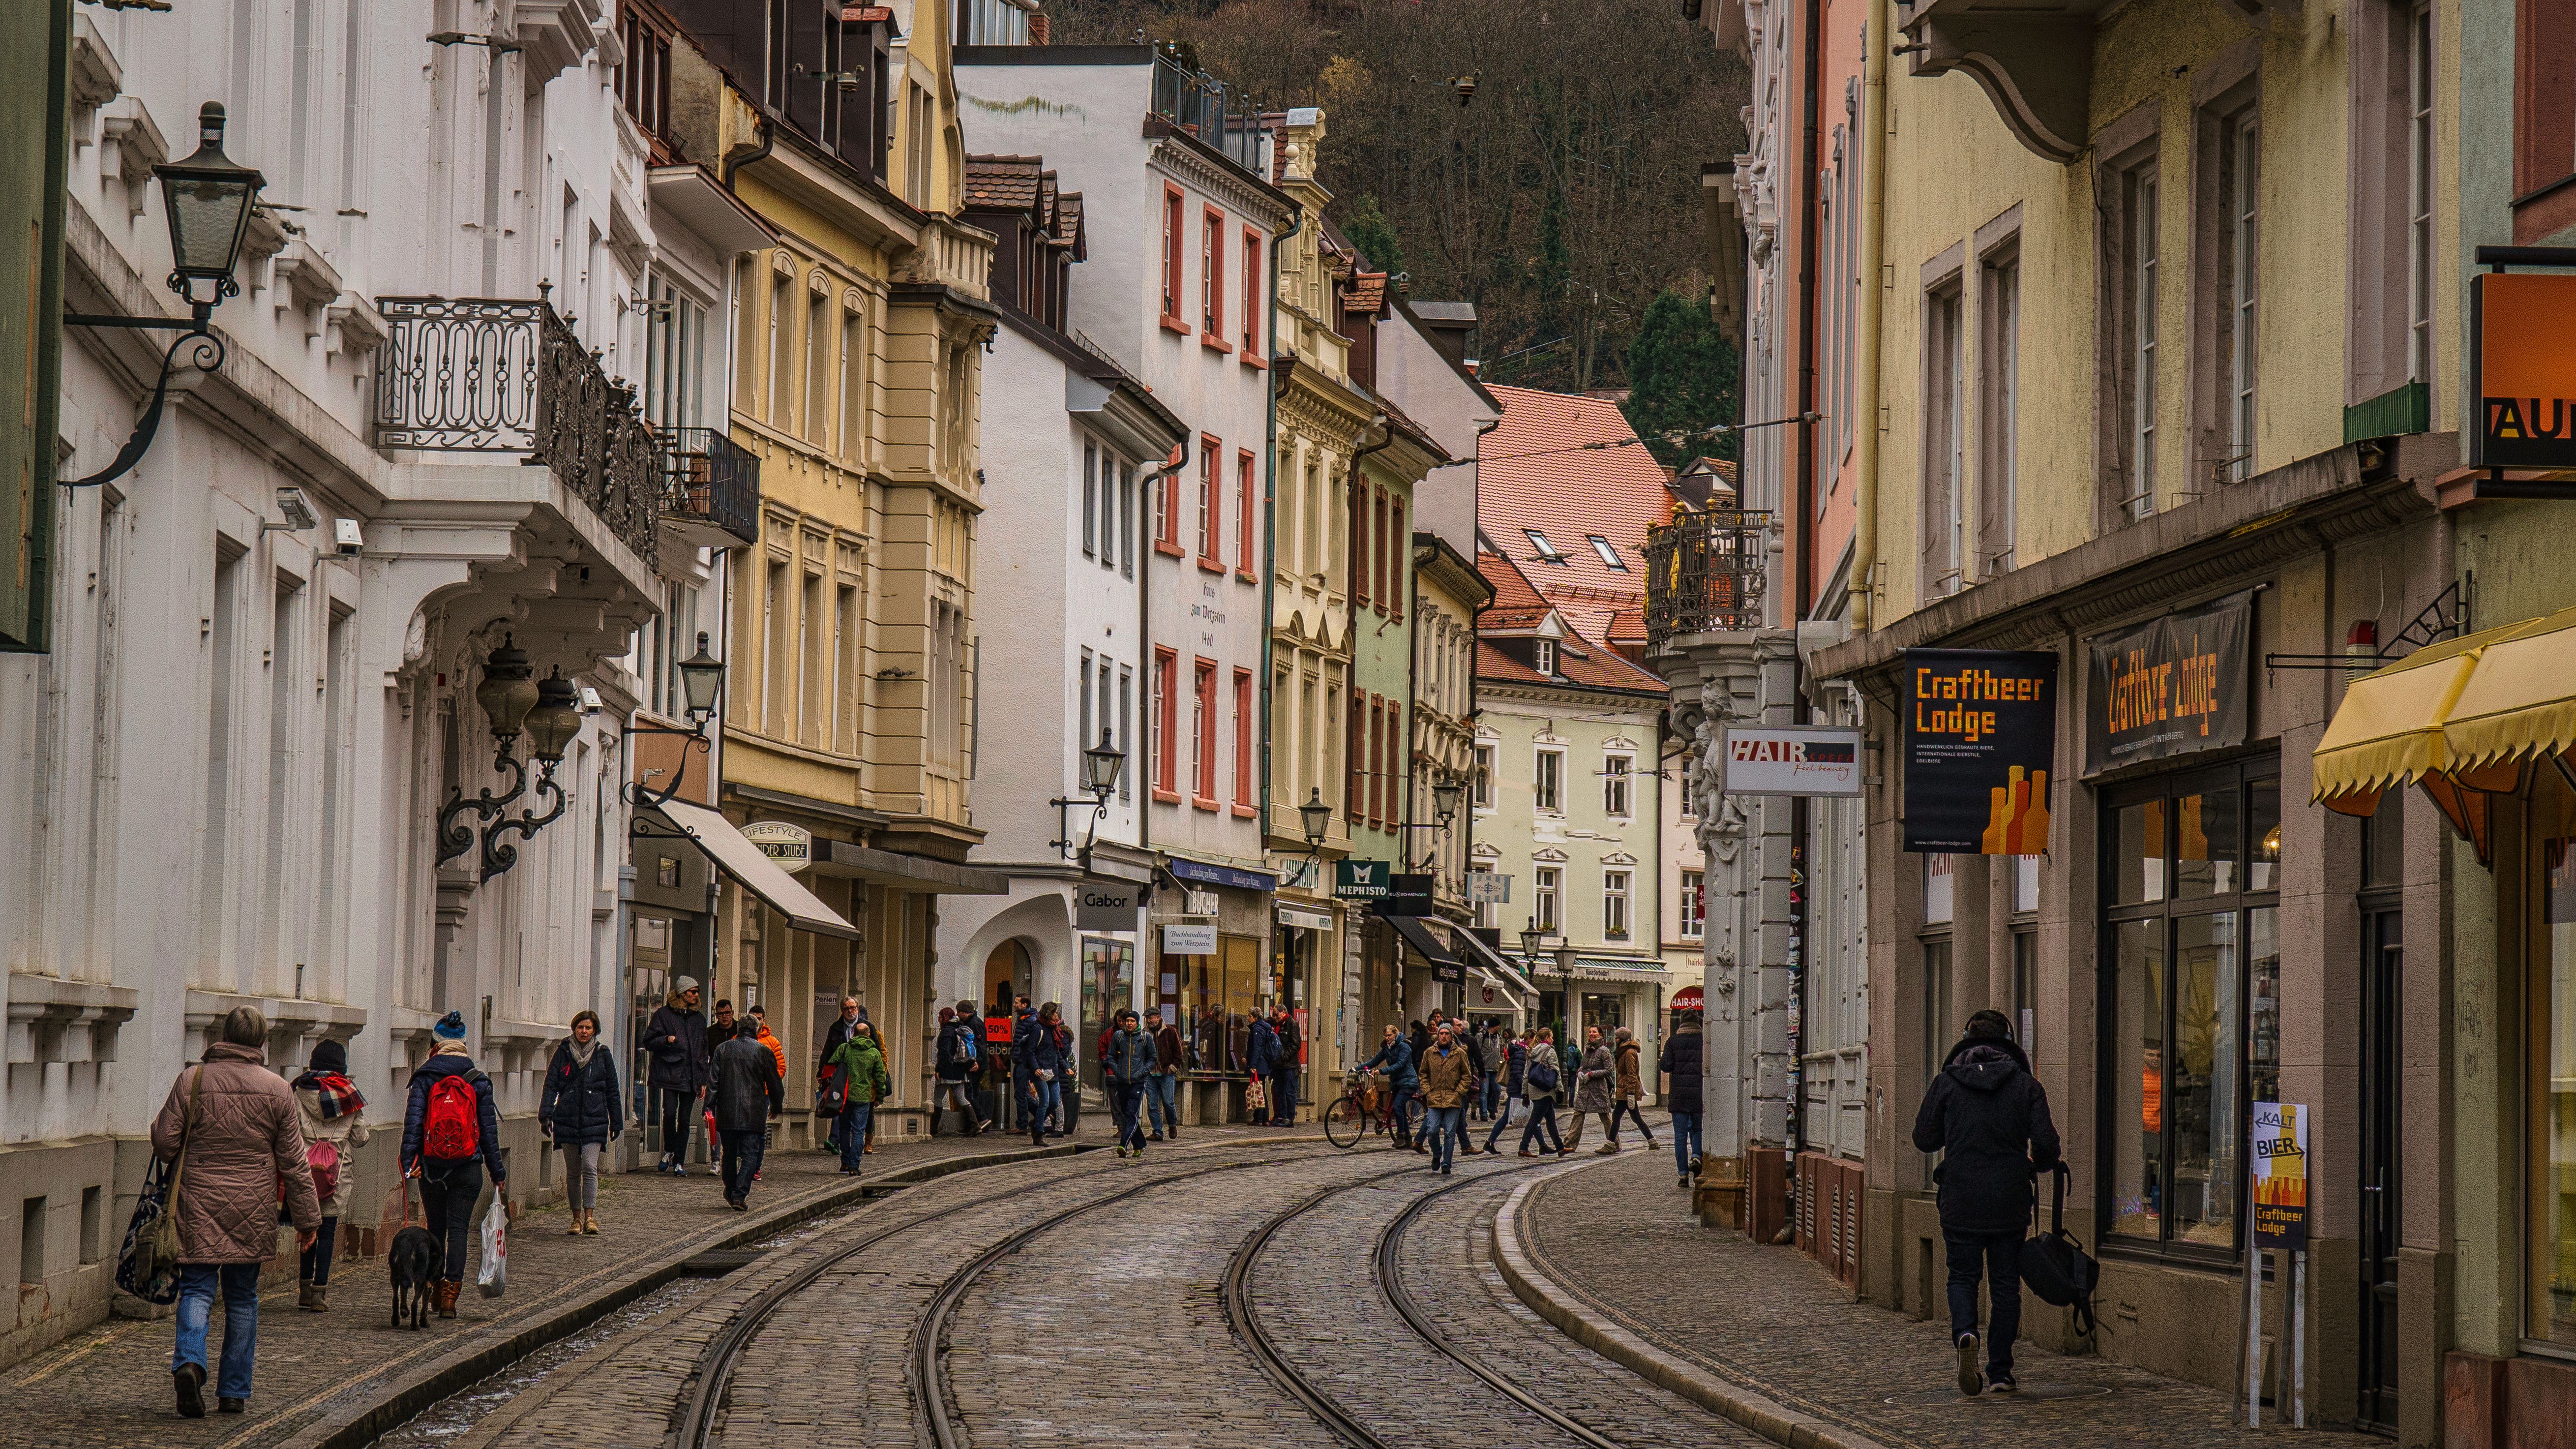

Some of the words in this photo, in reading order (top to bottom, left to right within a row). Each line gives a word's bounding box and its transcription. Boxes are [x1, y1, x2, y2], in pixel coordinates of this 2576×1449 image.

[1917, 668, 2044, 700] Craftbeer
[1917, 702, 1996, 741] Lodge
[1731, 741, 1806, 762] HAIR
[742, 826, 802, 841] LIFESTYLE
[783, 845, 805, 857] STUBE
[1338, 886, 1386, 896] MEPHISTO
[1084, 893, 1128, 907] Gabor
[1170, 931, 1210, 939] Buchhandlung
[988, 1025, 1008, 1035] 50%
[987, 1043, 1012, 1055] abor
[2263, 1111, 2295, 1127] KALT
[2256, 1137, 2296, 1156] BIER
[2256, 1207, 2303, 1222] Craftbeer
[2256, 1220, 2286, 1237] Lodge
